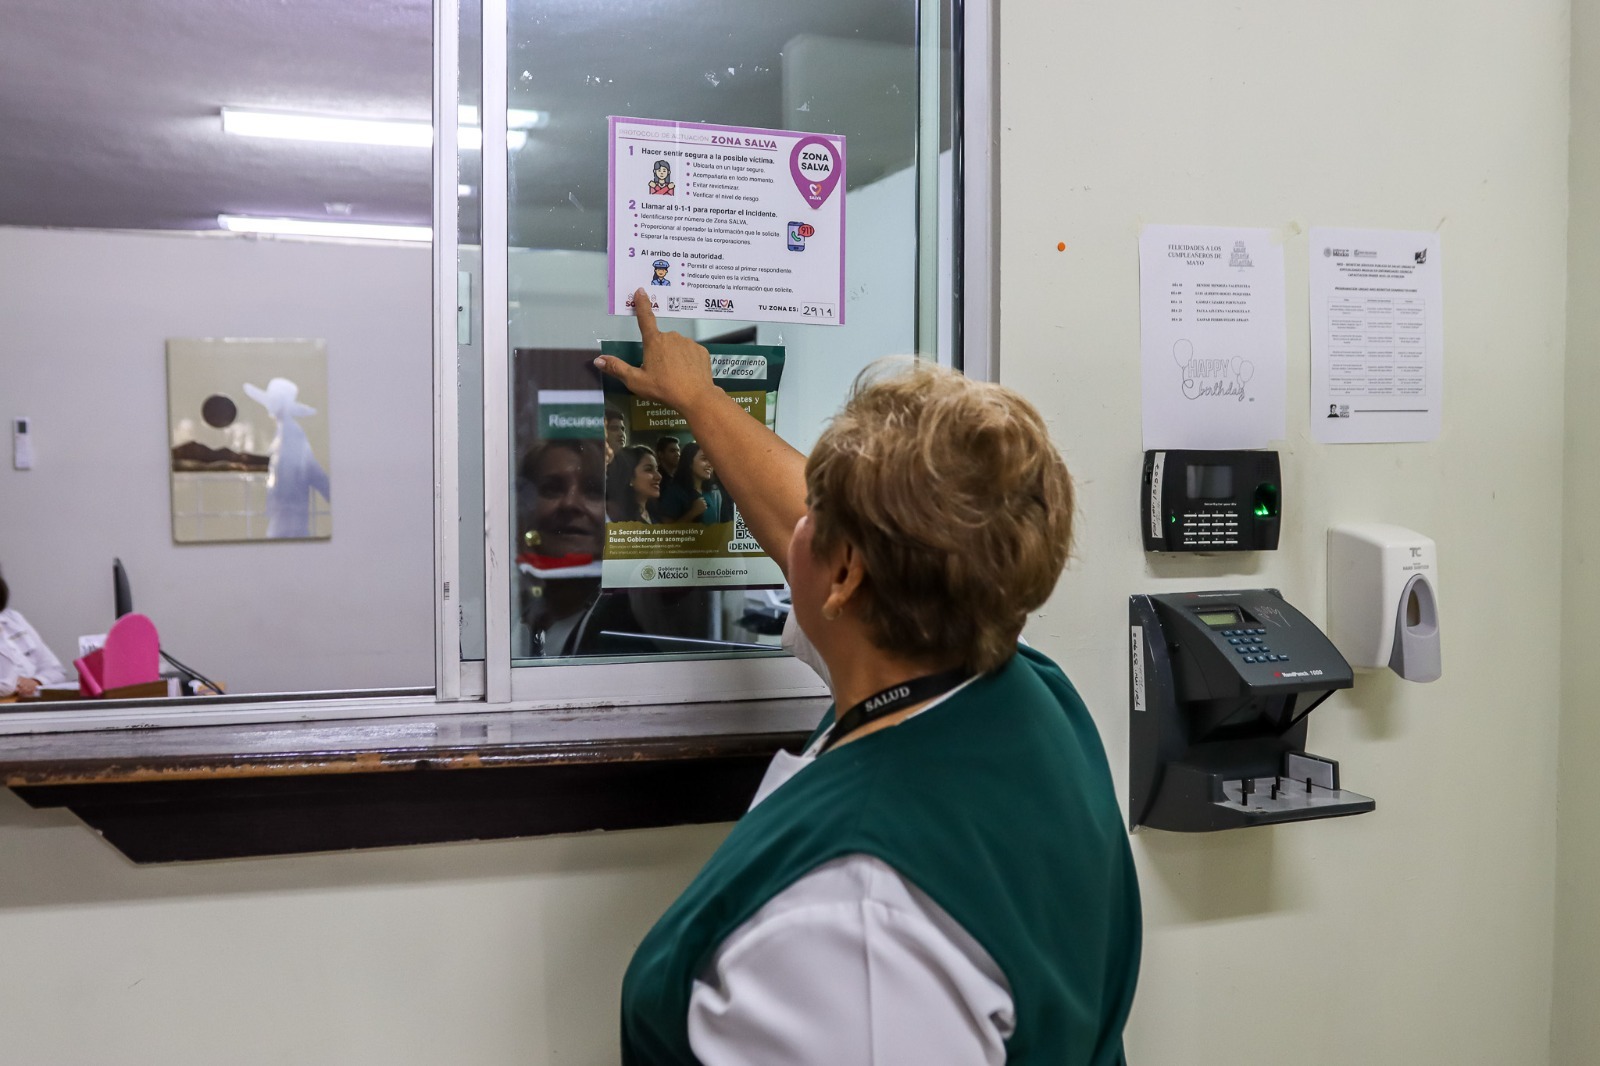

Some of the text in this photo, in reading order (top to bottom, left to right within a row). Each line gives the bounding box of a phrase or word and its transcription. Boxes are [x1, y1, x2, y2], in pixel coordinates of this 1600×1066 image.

[619, 129, 660, 138] PROTOCOLO
[711, 136, 741, 146] ZONA
[745, 138, 777, 149] SALVA
[629, 146, 634, 156] 1
[642, 147, 662, 156] Hacer
[684, 152, 708, 160] segura
[723, 154, 748, 162] posible
[802, 152, 828, 162] ZONA
[693, 162, 714, 170] Ubicarla
[801, 162, 830, 172] SALVA
[628, 200, 636, 210] 2
[641, 202, 665, 210] Llamar
[728, 218, 748, 226] SALVA.
[640, 223, 675, 231] Proporcionar
[714, 227, 744, 235] información
[801, 226, 812, 234] 911
[628, 247, 635, 257] 3
[690, 252, 724, 260] autoridad.
[687, 282, 725, 290] Proporcionarle
[733, 284, 761, 292] información
[712, 357, 766, 367] hostigamiento
[1188, 359, 1230, 378] HAPPY
[647, 408, 679, 416] residen
[1409, 547, 1421, 557] TC
[658, 571, 689, 579] México
[864, 686, 910, 712] SALUD
